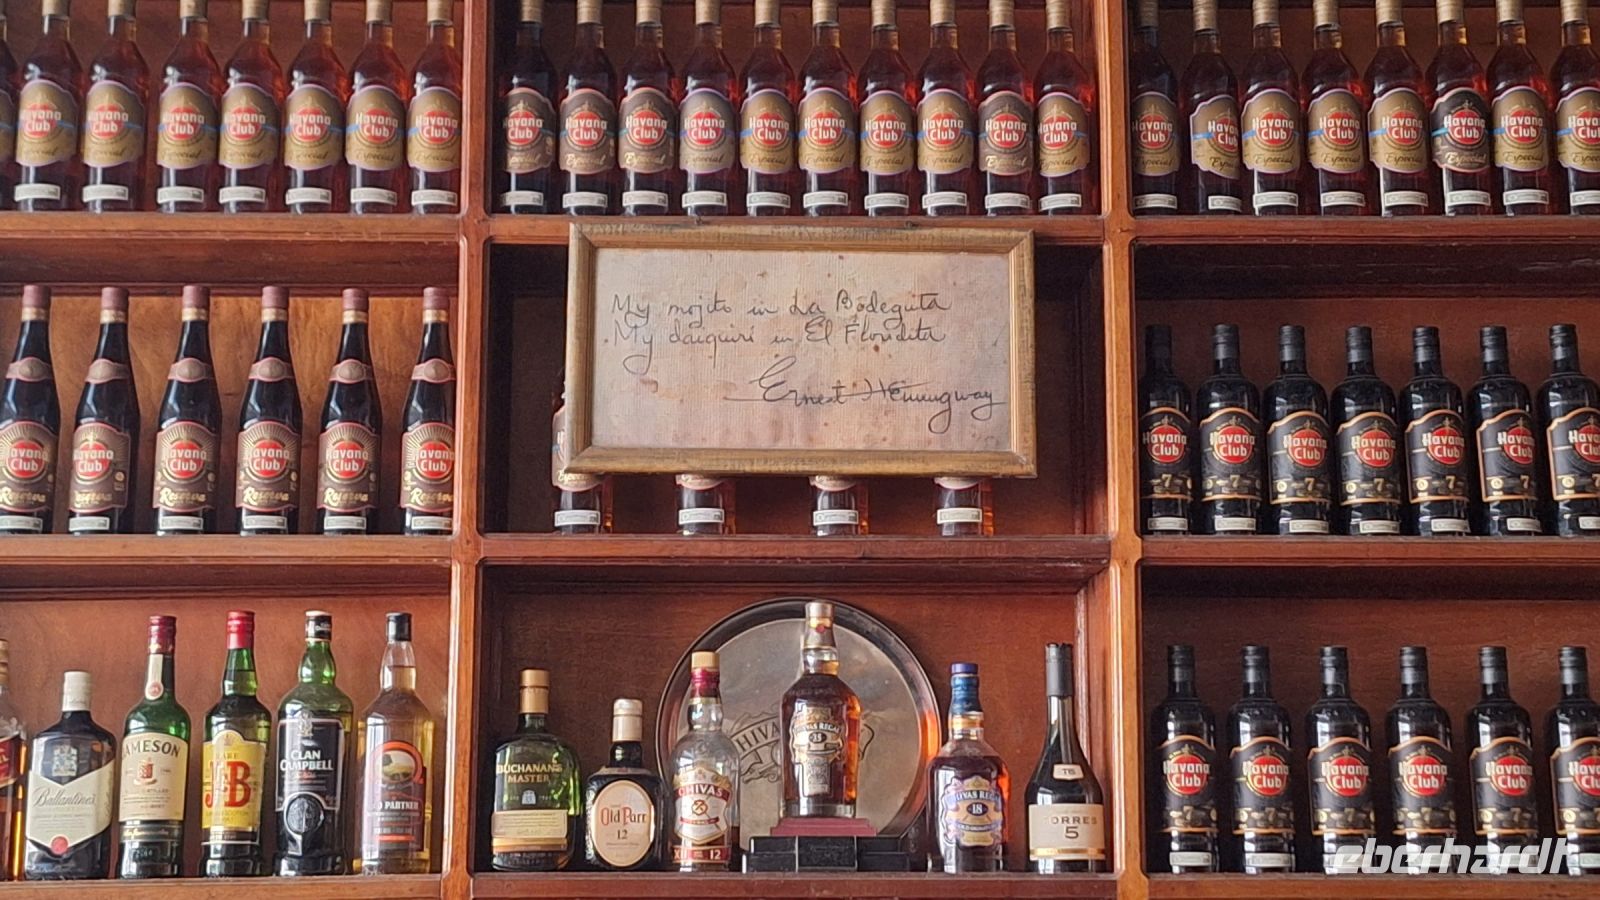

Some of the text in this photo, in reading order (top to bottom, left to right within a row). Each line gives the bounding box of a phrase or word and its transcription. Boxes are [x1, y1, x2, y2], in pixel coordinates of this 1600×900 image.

[20, 109, 62, 122] vana
[87, 110, 129, 123] vana
[163, 112, 205, 125] avana
[224, 112, 266, 125] avana
[356, 113, 399, 129] Havana
[416, 115, 459, 129] Havana
[626, 115, 668, 130] Havana
[684, 116, 726, 129] Havana
[1382, 115, 1423, 130] Havana
[1500, 115, 1544, 130] Havana
[749, 117, 790, 132] Havana
[804, 116, 846, 130] Havana
[865, 119, 907, 133] Havana
[922, 117, 964, 131] Havana
[985, 118, 1027, 133] Havana
[1252, 116, 1295, 131] Havana
[1319, 116, 1361, 131] Havana
[1443, 115, 1486, 131] Havana
[296, 125, 322, 138] Club
[364, 124, 391, 138] Club
[424, 126, 450, 139] Club
[509, 129, 534, 141] Club
[573, 130, 599, 142] Club
[634, 129, 660, 141] Club
[691, 128, 717, 140] Club
[756, 128, 782, 142] Club
[812, 127, 839, 140] Club
[873, 130, 899, 143] Club
[930, 127, 955, 141] Club
[993, 129, 1019, 143] Club
[1044, 130, 1069, 144] Club
[1140, 131, 1167, 144] Club
[1260, 128, 1287, 141] Club
[1328, 128, 1355, 142] Club
[1391, 126, 1418, 141] Club
[1454, 127, 1481, 142] Club
[1510, 126, 1537, 140] Club
[611, 293, 651, 329] My
[667, 291, 733, 329] mojito
[747, 298, 780, 316] in
[612, 321, 654, 377] My
[668, 322, 755, 368] daiquiri
[770, 331, 800, 344] in
[804, 315, 833, 345] El
[745, 355, 1008, 434] Ernest Hemingway
[1142, 431, 1187, 446] Havana
[1210, 430, 1255, 446] Havana
[1284, 433, 1328, 449] Havana
[1352, 433, 1396, 449] Havana
[4, 447, 50, 461] avana
[73, 448, 114, 461] avana
[163, 447, 207, 461] avana
[246, 447, 290, 461] avana
[411, 447, 455, 461] avana
[1152, 443, 1180, 457] Club
[1219, 443, 1247, 457] Club
[1293, 445, 1320, 461] Club
[1362, 445, 1390, 461] Club
[1434, 443, 1461, 459] Club
[11, 458, 39, 471] Club
[170, 458, 198, 471] Club
[253, 458, 281, 471] Club
[333, 459, 360, 472] Club
[420, 458, 448, 472] Club
[1161, 473, 1173, 488] 7
[1229, 473, 1240, 488] 7
[1304, 477, 1315, 492] 7
[1373, 477, 1384, 492] 7
[1445, 474, 1456, 490] 7
[1520, 474, 1530, 489] 7
[124, 739, 180, 758] AMESON
[290, 750, 321, 761] CLAN
[1243, 761, 1289, 776] Havana
[1322, 761, 1369, 777] Havana
[1171, 773, 1201, 788] Club
[1252, 774, 1281, 789] Club
[1332, 774, 1361, 789] Club
[1413, 773, 1439, 788] Club
[1499, 774, 1527, 788] Club
[677, 782, 724, 798] CHIVAS
[601, 807, 621, 826] Old
[1044, 816, 1098, 825] ORRES
[617, 829, 628, 840] 12
[1065, 826, 1079, 840] 5
[709, 848, 721, 861] 12
